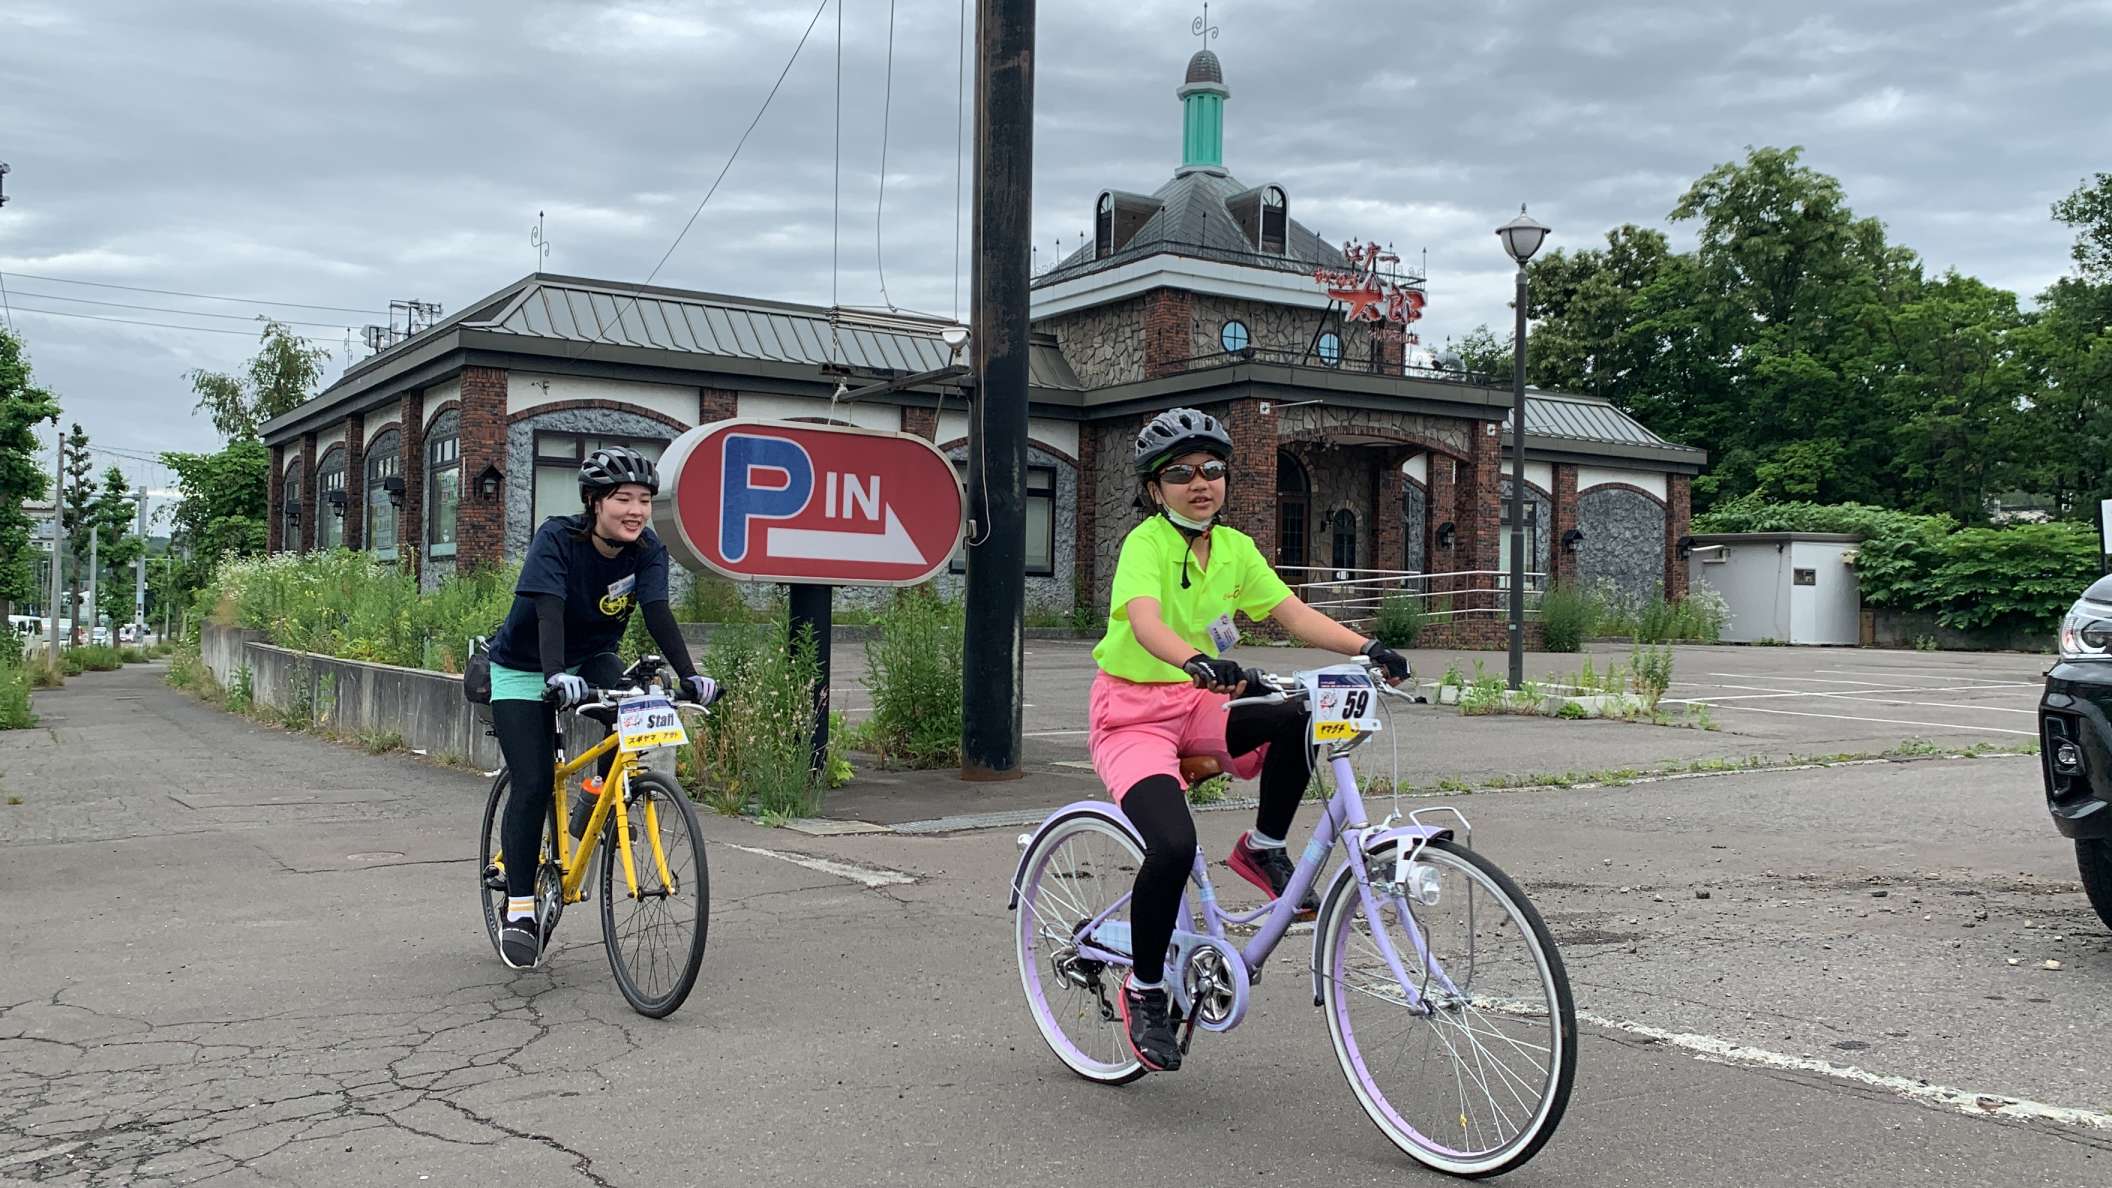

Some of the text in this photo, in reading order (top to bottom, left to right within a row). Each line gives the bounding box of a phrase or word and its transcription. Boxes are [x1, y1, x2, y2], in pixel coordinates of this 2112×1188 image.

[718, 432, 881, 564] P IN
[1342, 690, 1369, 719] 59
